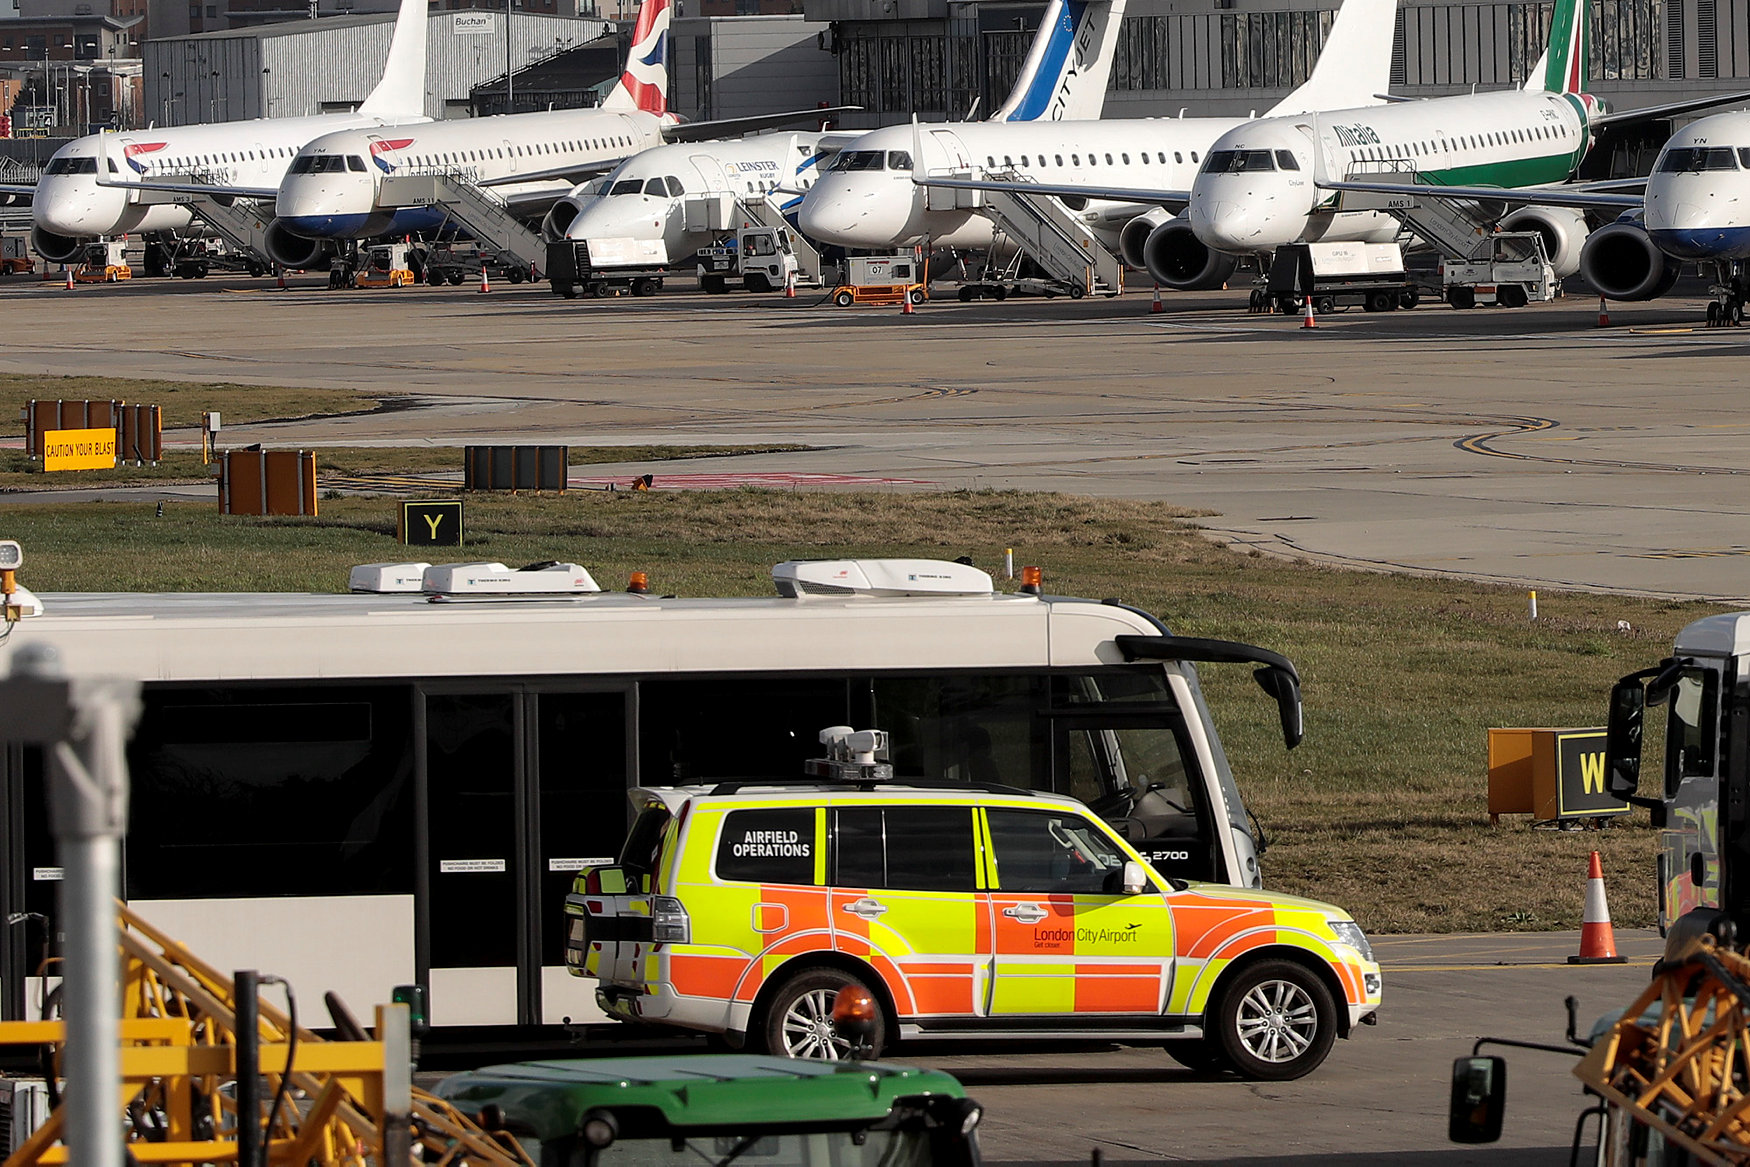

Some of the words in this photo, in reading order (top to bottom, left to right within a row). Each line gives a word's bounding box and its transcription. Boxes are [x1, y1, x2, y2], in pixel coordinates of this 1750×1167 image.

[455, 17, 487, 26] Buchan
[1052, 12, 1096, 121] CITYJET
[45, 117, 51, 126] 4
[1332, 123, 1381, 147] Alitalia
[736, 160, 780, 172] LEINSTER
[1388, 200, 1404, 208] AMS
[872, 266, 882, 275] 07
[46, 443, 74, 458] CAUTION
[75, 442, 93, 456] YOUR
[95, 441, 114, 455] BLAST
[423, 514, 444, 540] Y
[1580, 751, 1606, 795] W
[744, 831, 798, 843] AIRFIELD
[733, 844, 810, 857] OPERATIONS
[1153, 851, 1189, 860] 2700
[1034, 927, 1075, 941] London
